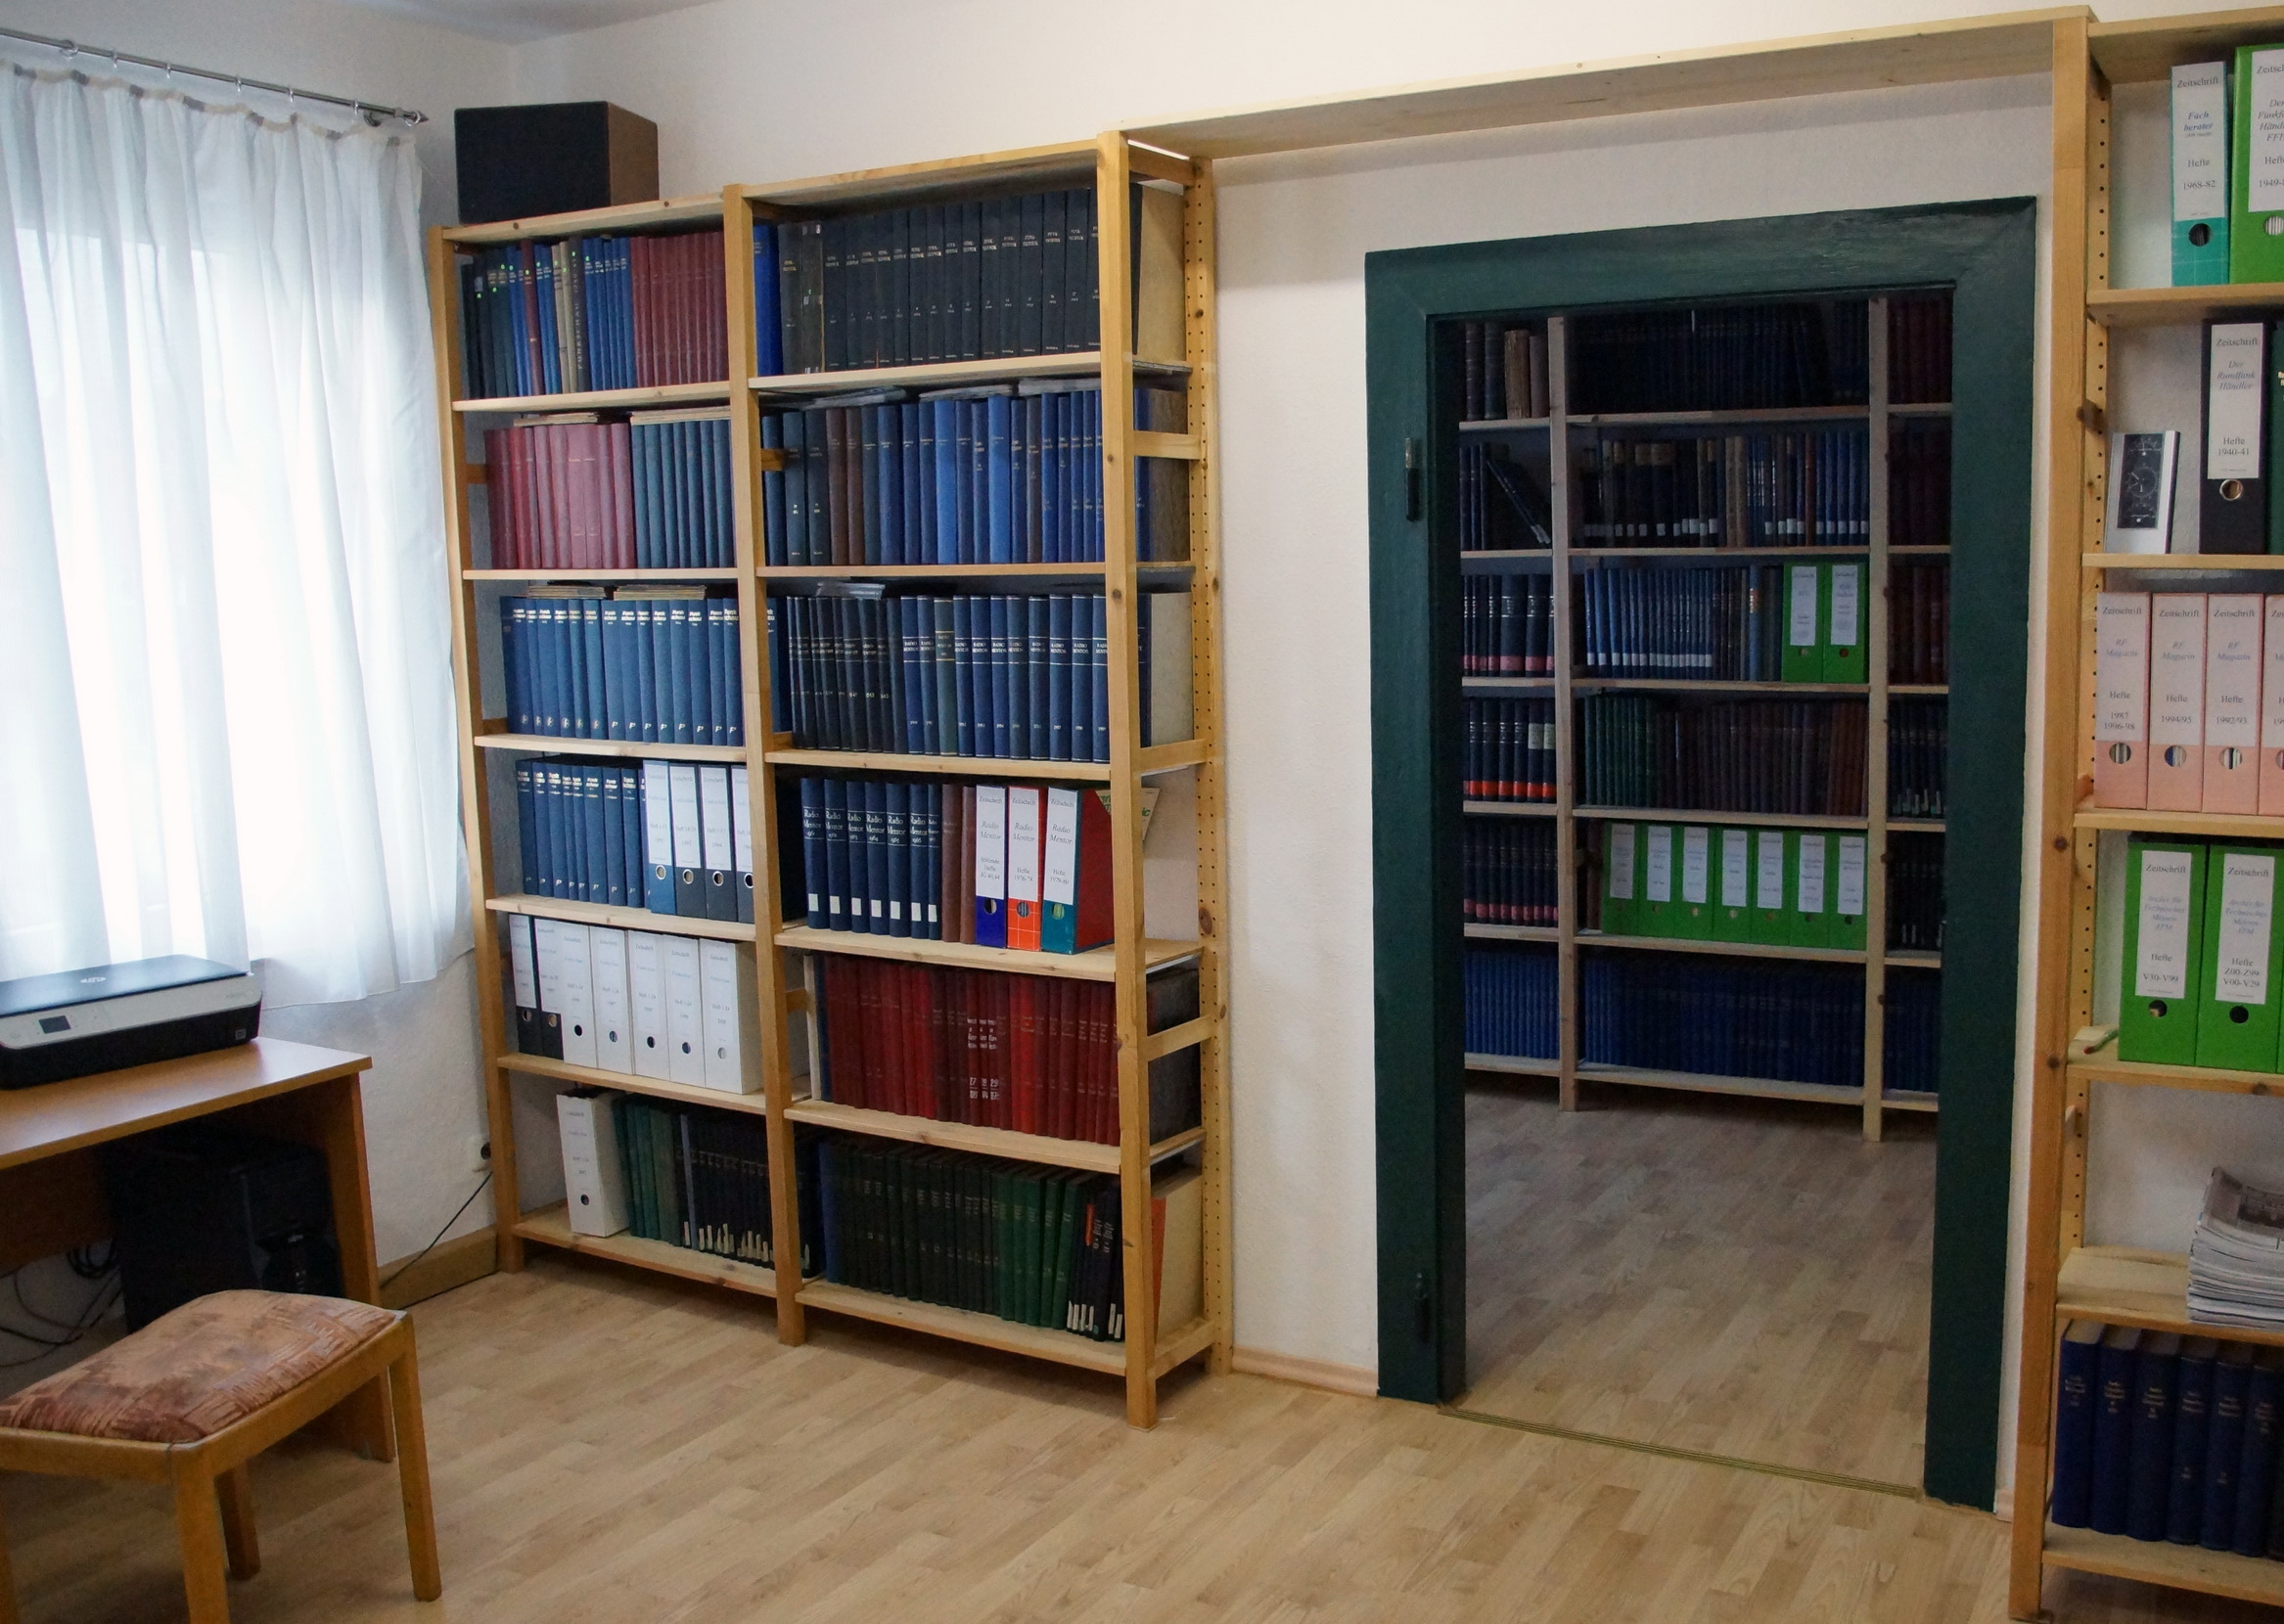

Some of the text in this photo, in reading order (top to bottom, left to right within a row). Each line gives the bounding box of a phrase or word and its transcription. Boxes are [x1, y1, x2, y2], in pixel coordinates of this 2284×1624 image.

[2177, 77, 2218, 88] Zeitschrift
[2188, 111, 2209, 120] Fach
[2216, 338, 2259, 347] Zeitschrift
[2222, 436, 2245, 445] Hefte
[2102, 607, 2142, 615] Zeitschrift
[2159, 609, 2200, 618] Zeitschrift
[2214, 609, 2255, 618] Zeitschrift
[2109, 691, 2130, 699] Hefte
[2220, 695, 2243, 703] Hefte
[1015, 822, 1033, 831] Radio
[1052, 824, 1071, 834] Radio
[1050, 835, 1073, 844] Mentor
[2146, 864, 2186, 874] Zeitschrift
[2227, 867, 2269, 878] Zeitschrift
[2151, 953, 2172, 963] Hefte
[2232, 958, 2254, 967] Hefte
